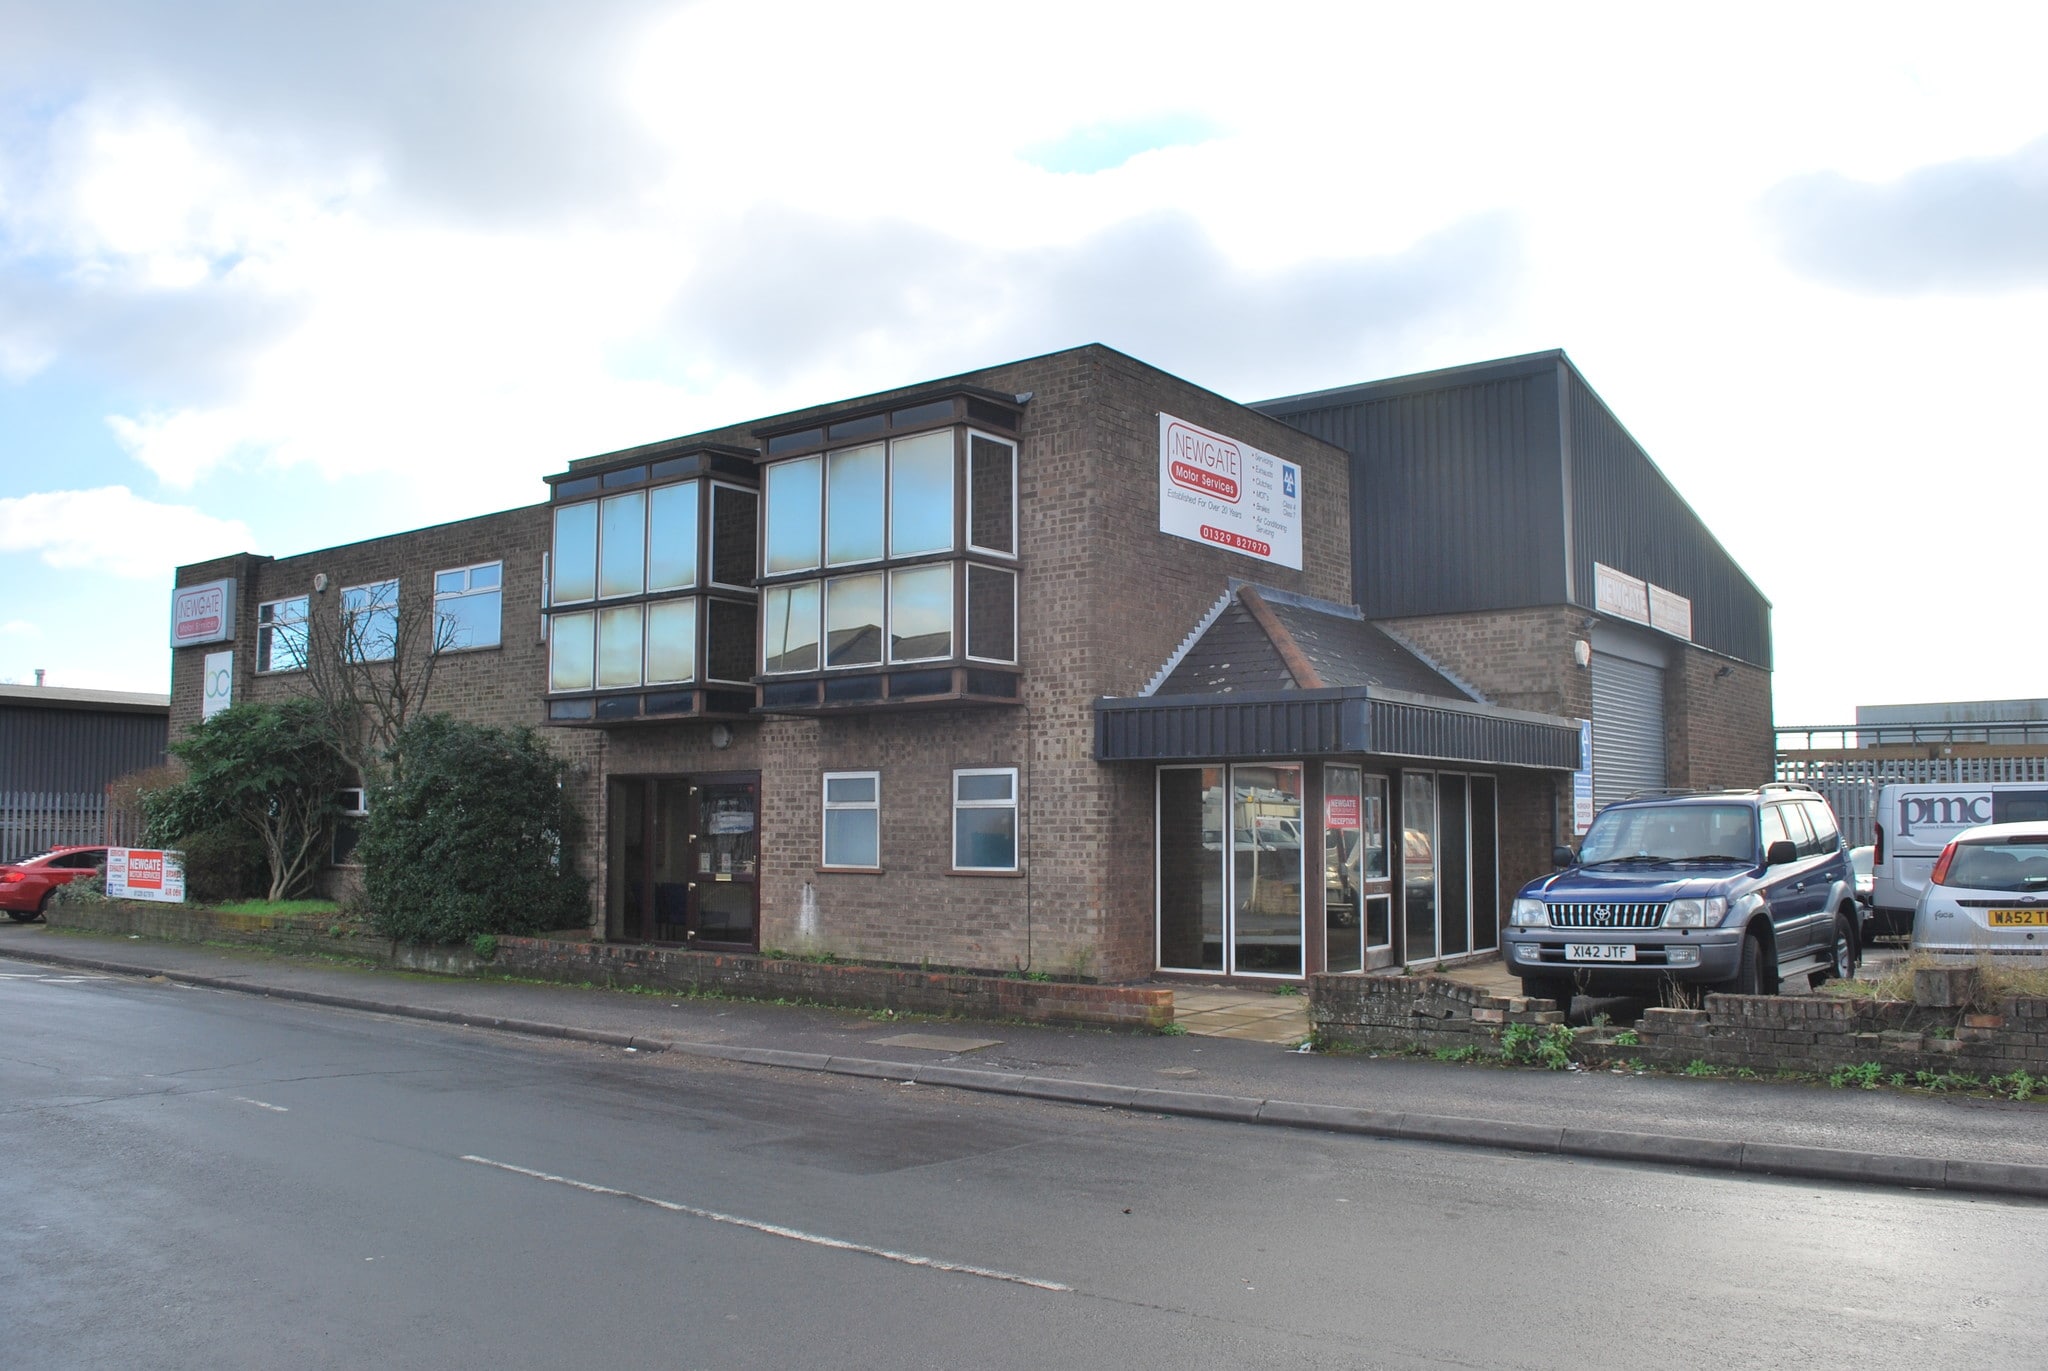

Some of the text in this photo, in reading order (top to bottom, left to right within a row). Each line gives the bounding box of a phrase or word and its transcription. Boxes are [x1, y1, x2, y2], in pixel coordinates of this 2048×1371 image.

[1175, 432, 1236, 475] NEWGATE
[1176, 465, 1234, 494] Motor Services
[1167, 488, 1242, 519] Established For Over 20 Years
[1264, 517, 1288, 533] Conditioning
[1203, 527, 1268, 554] 01329 827979
[180, 594, 219, 618] NEWGATE
[1897, 796, 1991, 837] pmc
[129, 858, 161, 871] NEWGATE
[1994, 911, 2048, 924] WA52 T
[1573, 945, 1627, 958] X142 JTF
